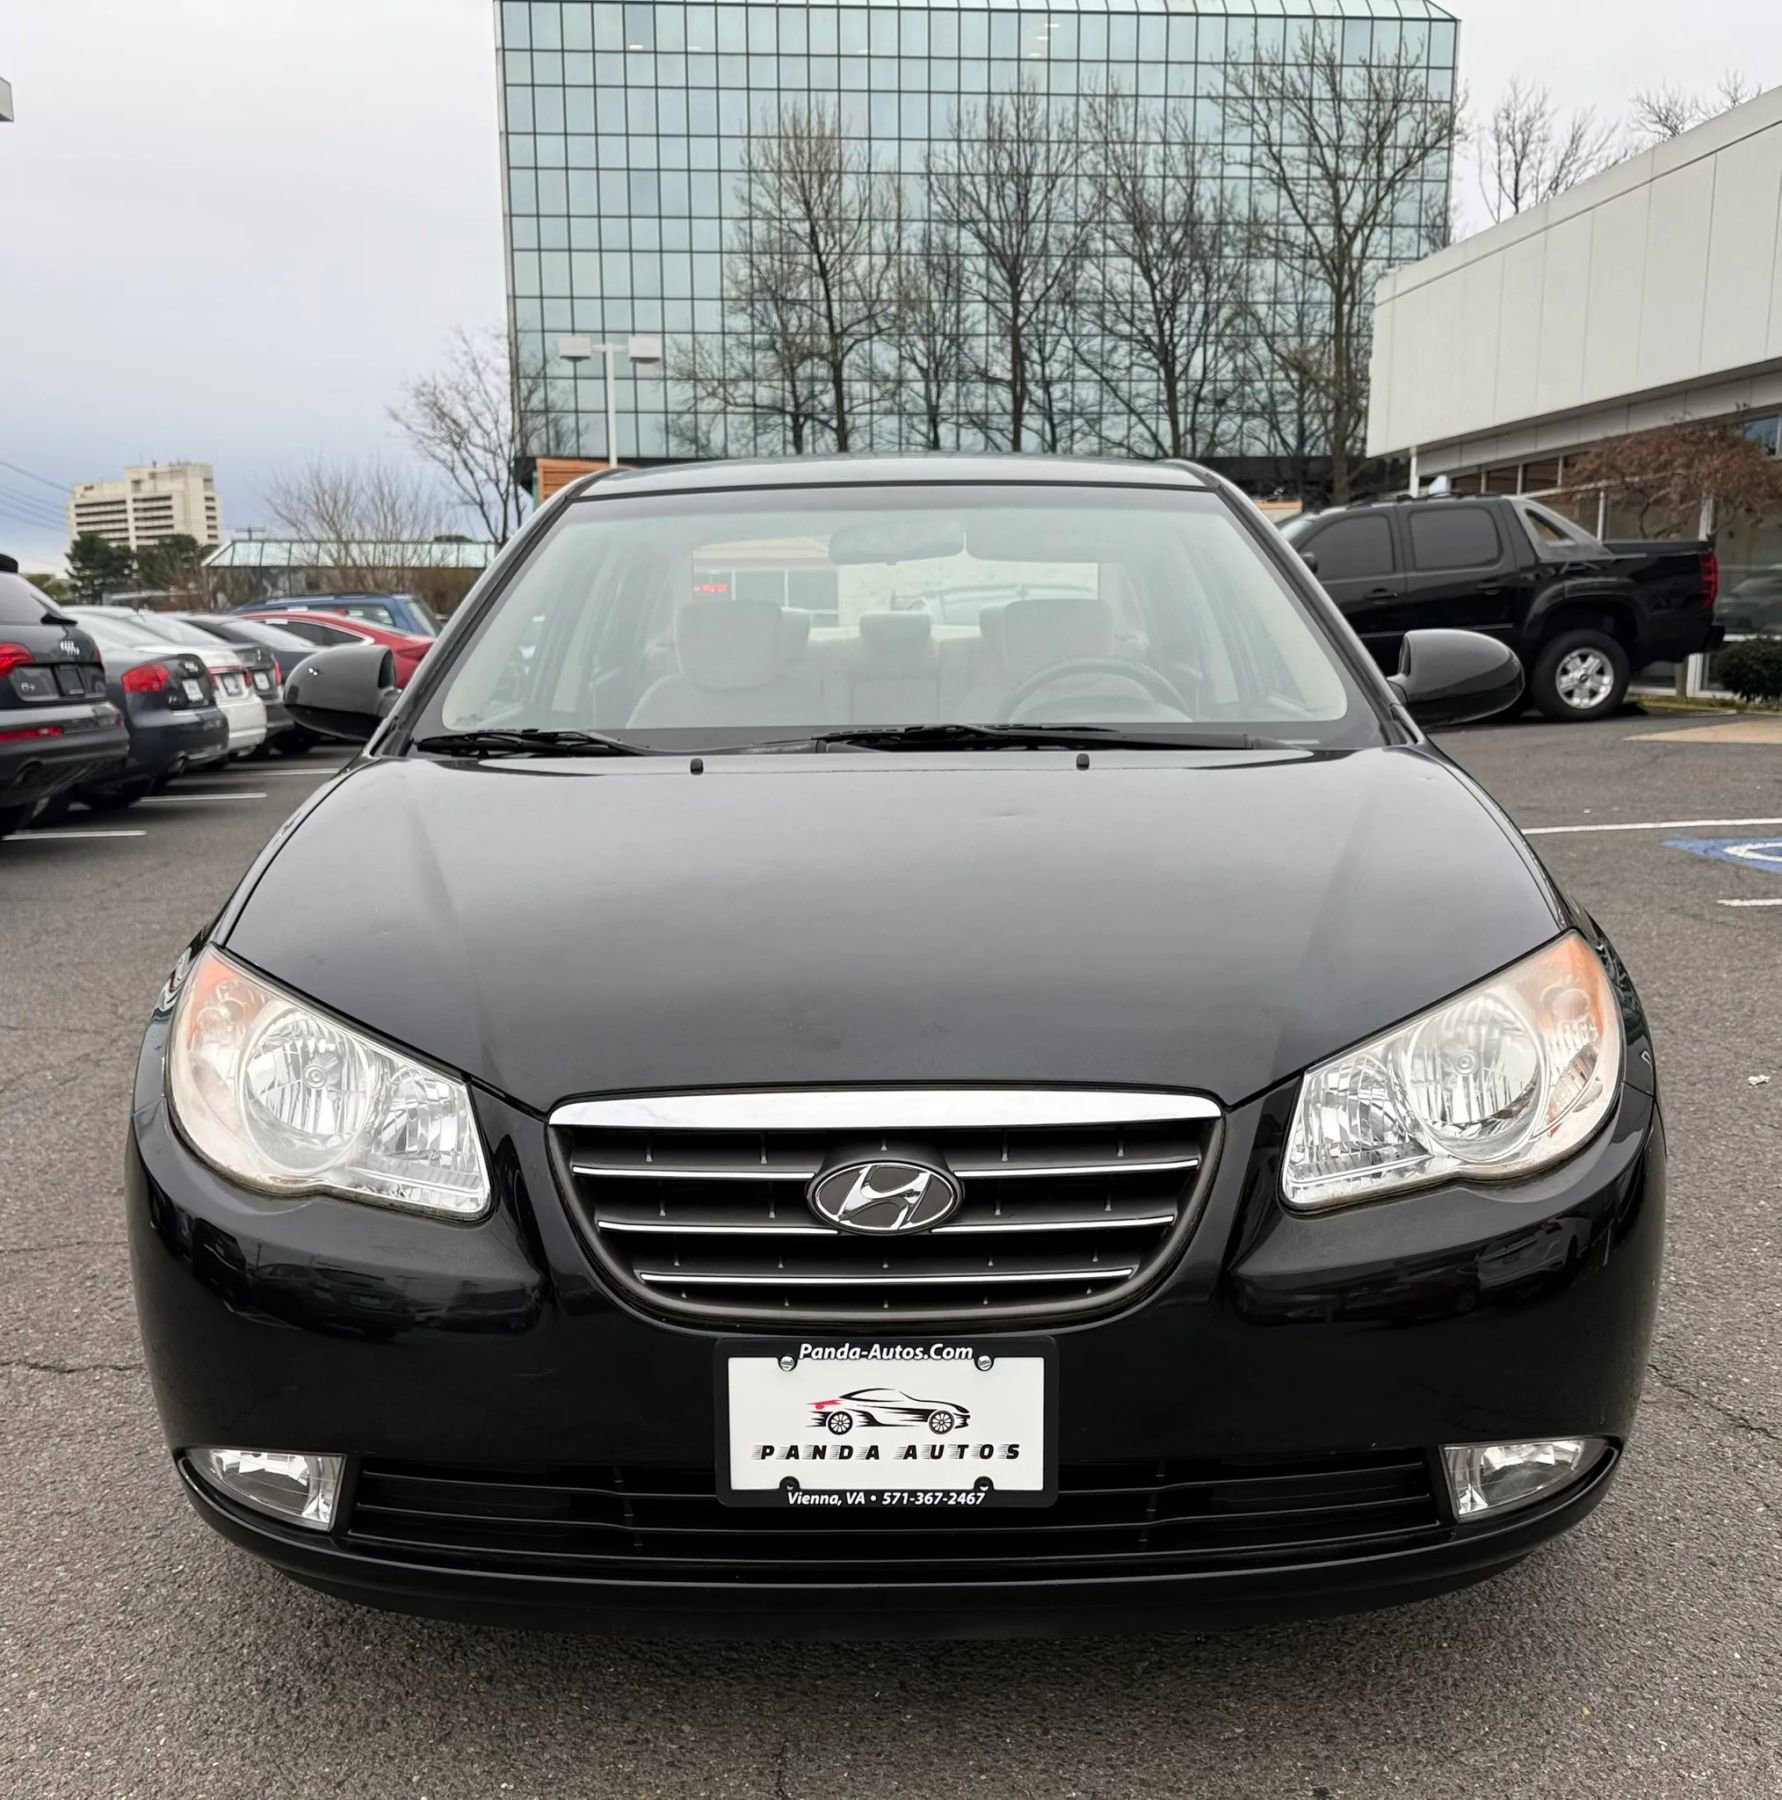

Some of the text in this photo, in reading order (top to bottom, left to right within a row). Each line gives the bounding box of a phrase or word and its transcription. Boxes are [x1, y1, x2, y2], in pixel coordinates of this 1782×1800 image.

[799, 1343, 974, 1360] Panda-Autos.Com
[753, 1444, 1020, 1460] PANDA AUTOS
[787, 1491, 986, 1506] Vienna, VA 571-367-2467
